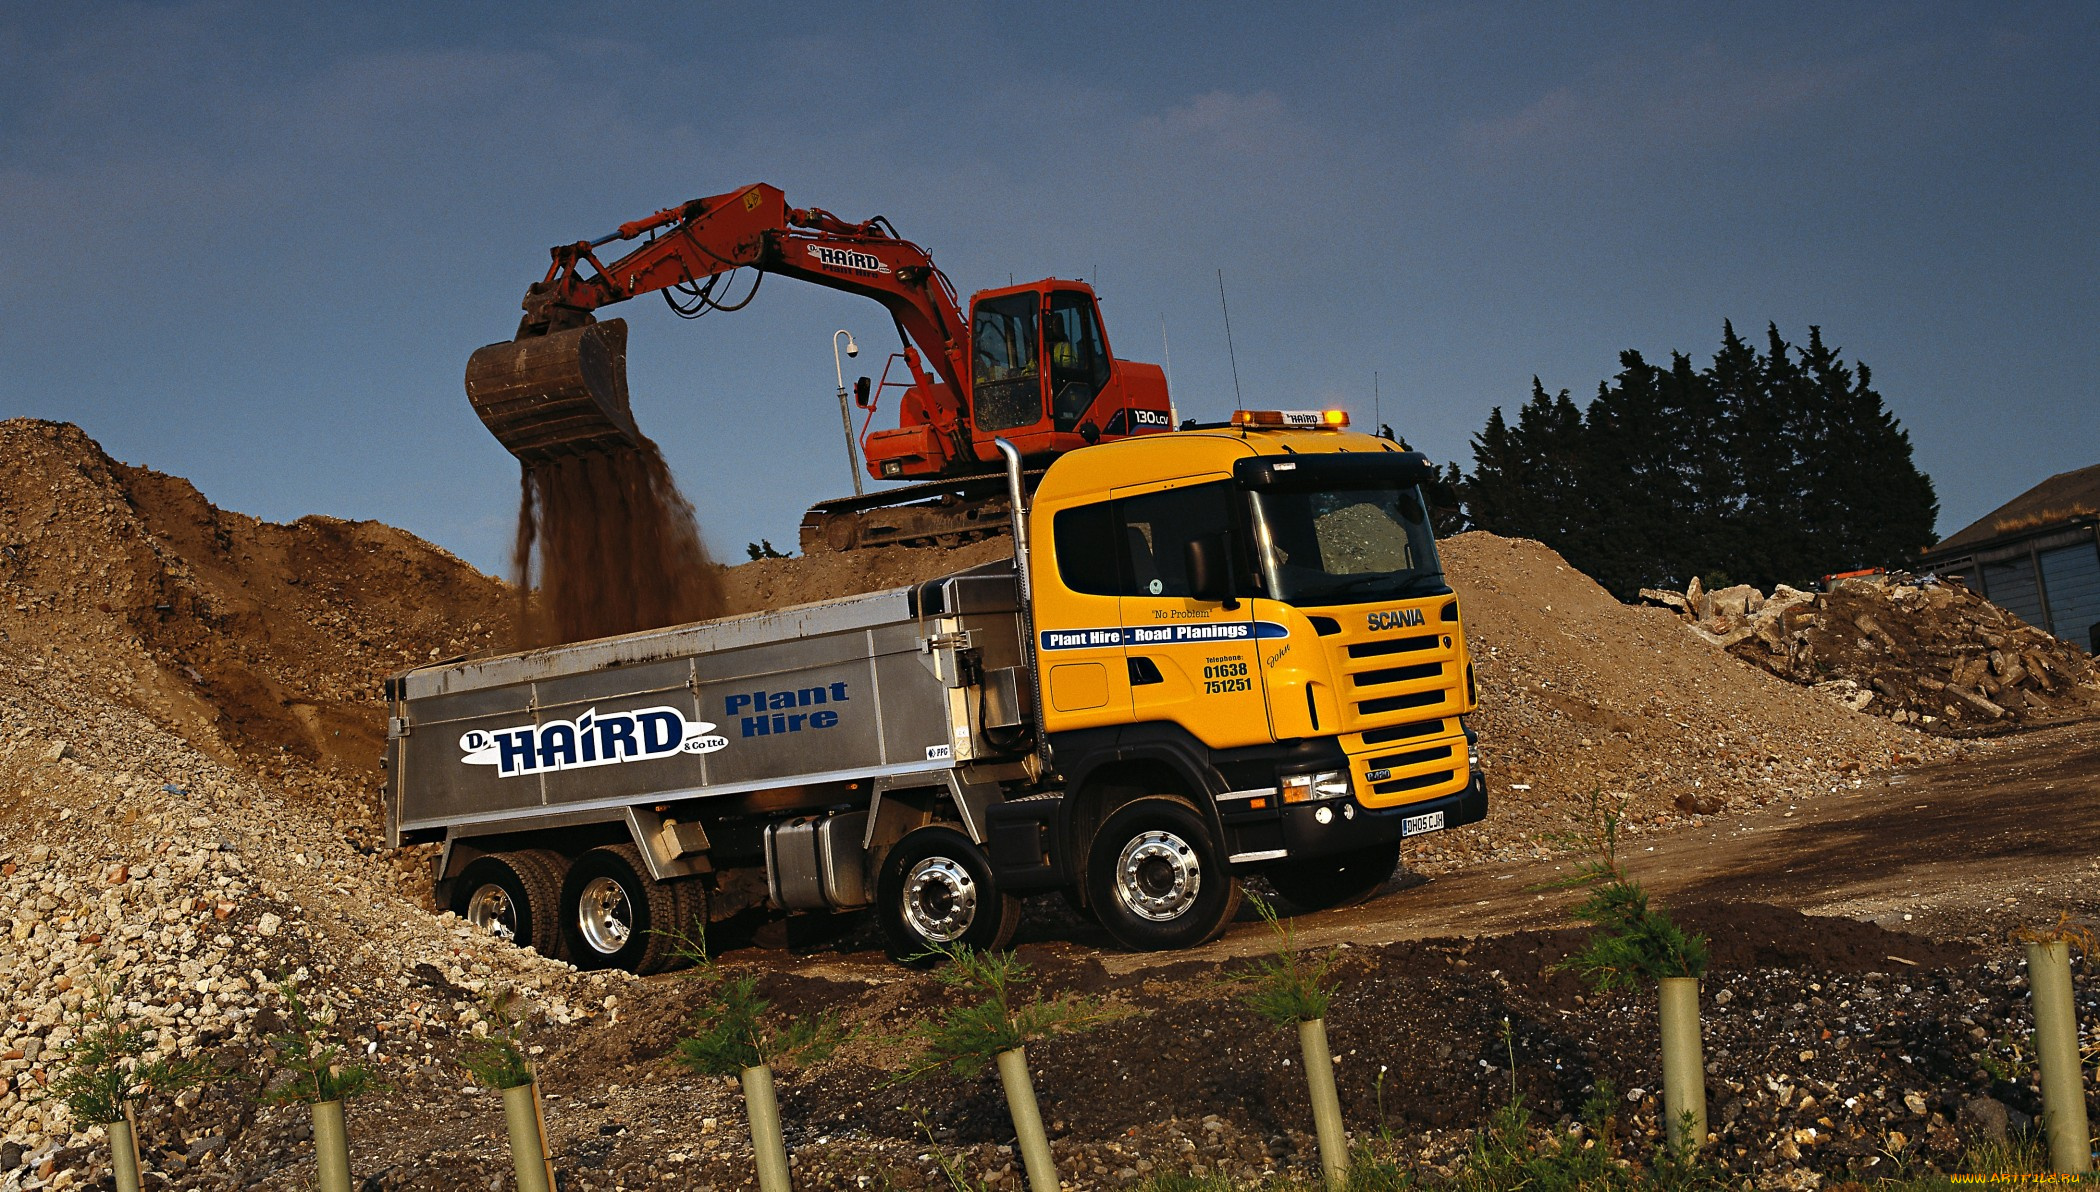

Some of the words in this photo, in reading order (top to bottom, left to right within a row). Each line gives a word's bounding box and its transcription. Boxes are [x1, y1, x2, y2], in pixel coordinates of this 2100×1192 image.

[1152, 609, 1167, 619] "No
[1171, 608, 1212, 619] Problem"
[1367, 608, 1425, 631] SCANIA
[1050, 632, 1087, 647] Plant
[1090, 629, 1120, 645] Hire
[1135, 626, 1172, 642] Road
[1177, 624, 1248, 641] Planings
[1206, 655, 1244, 664] Telephone:
[1267, 643, 1291, 667] John
[1204, 663, 1248, 679] 01638
[1204, 678, 1252, 694] 751251
[725, 681, 849, 716] Plant
[740, 710, 839, 738] Hire
[685, 743, 691, 751] &
[692, 741, 706, 750] Co
[707, 738, 724, 747] Ltd
[1407, 817, 1428, 833] DH05
[1428, 813, 1443, 829] CJH
